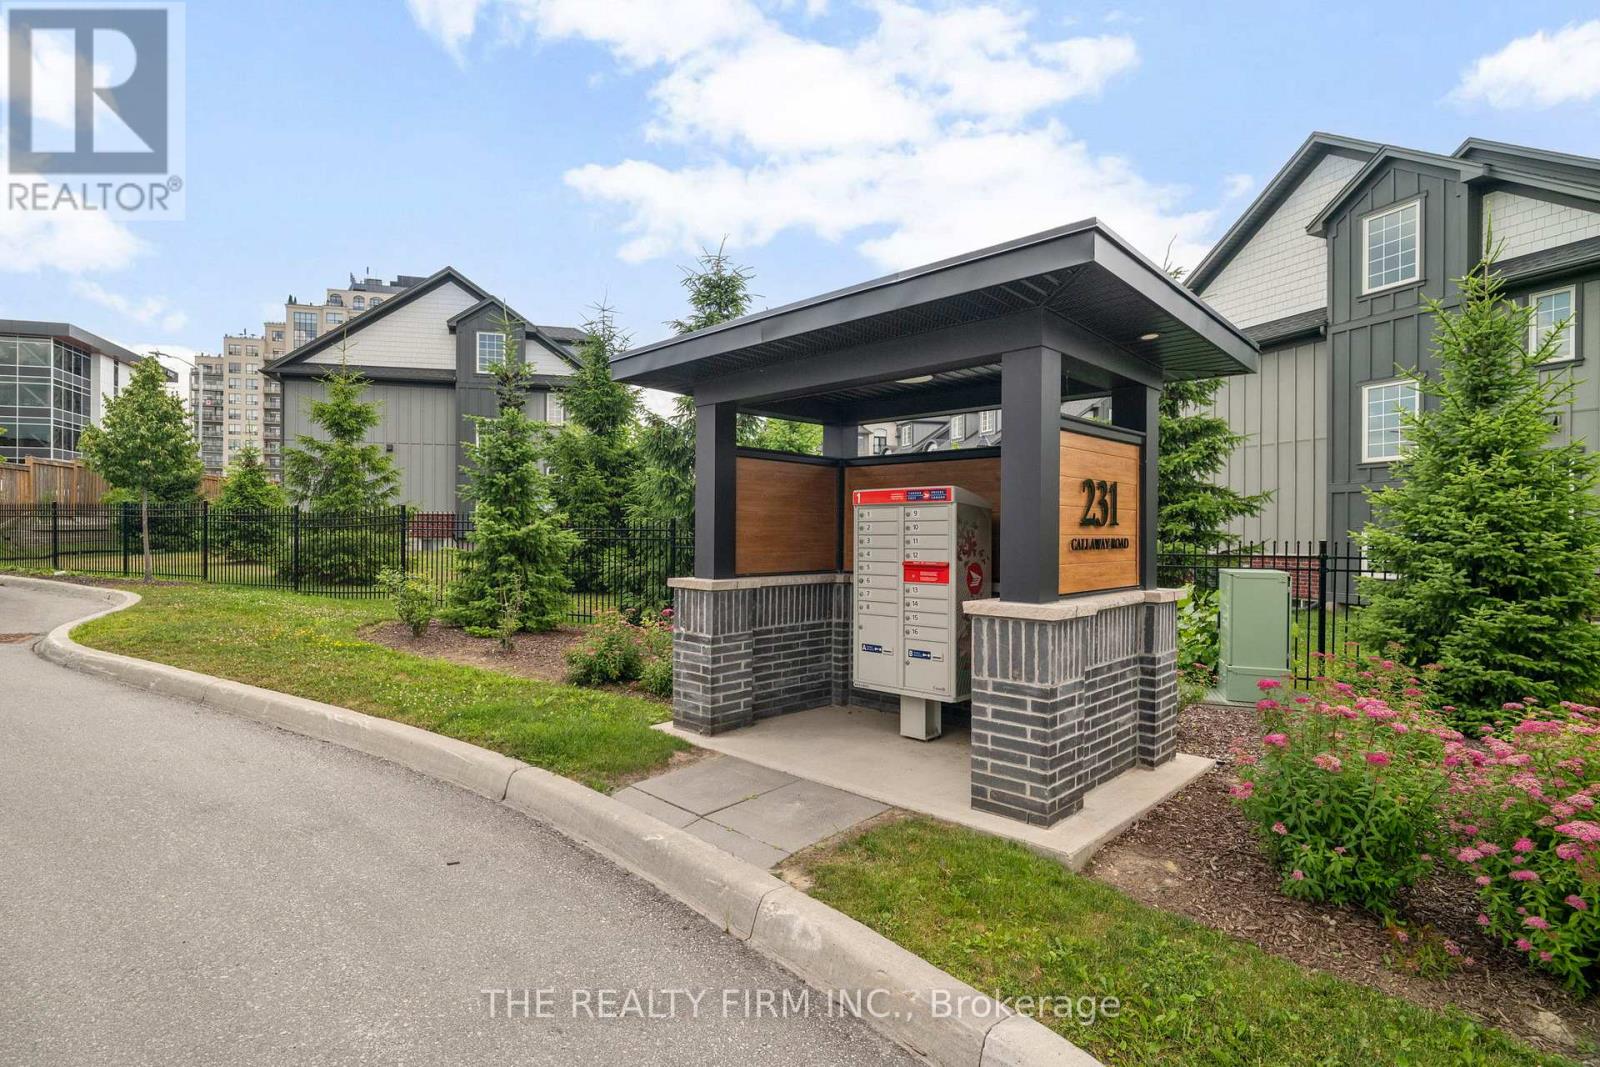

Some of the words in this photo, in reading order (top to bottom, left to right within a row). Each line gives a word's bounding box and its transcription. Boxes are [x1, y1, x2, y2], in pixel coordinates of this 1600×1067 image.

[856, 492, 861, 504] 1
[1080, 479, 1119, 527] 231
[1110, 537, 1130, 550] ROAD
